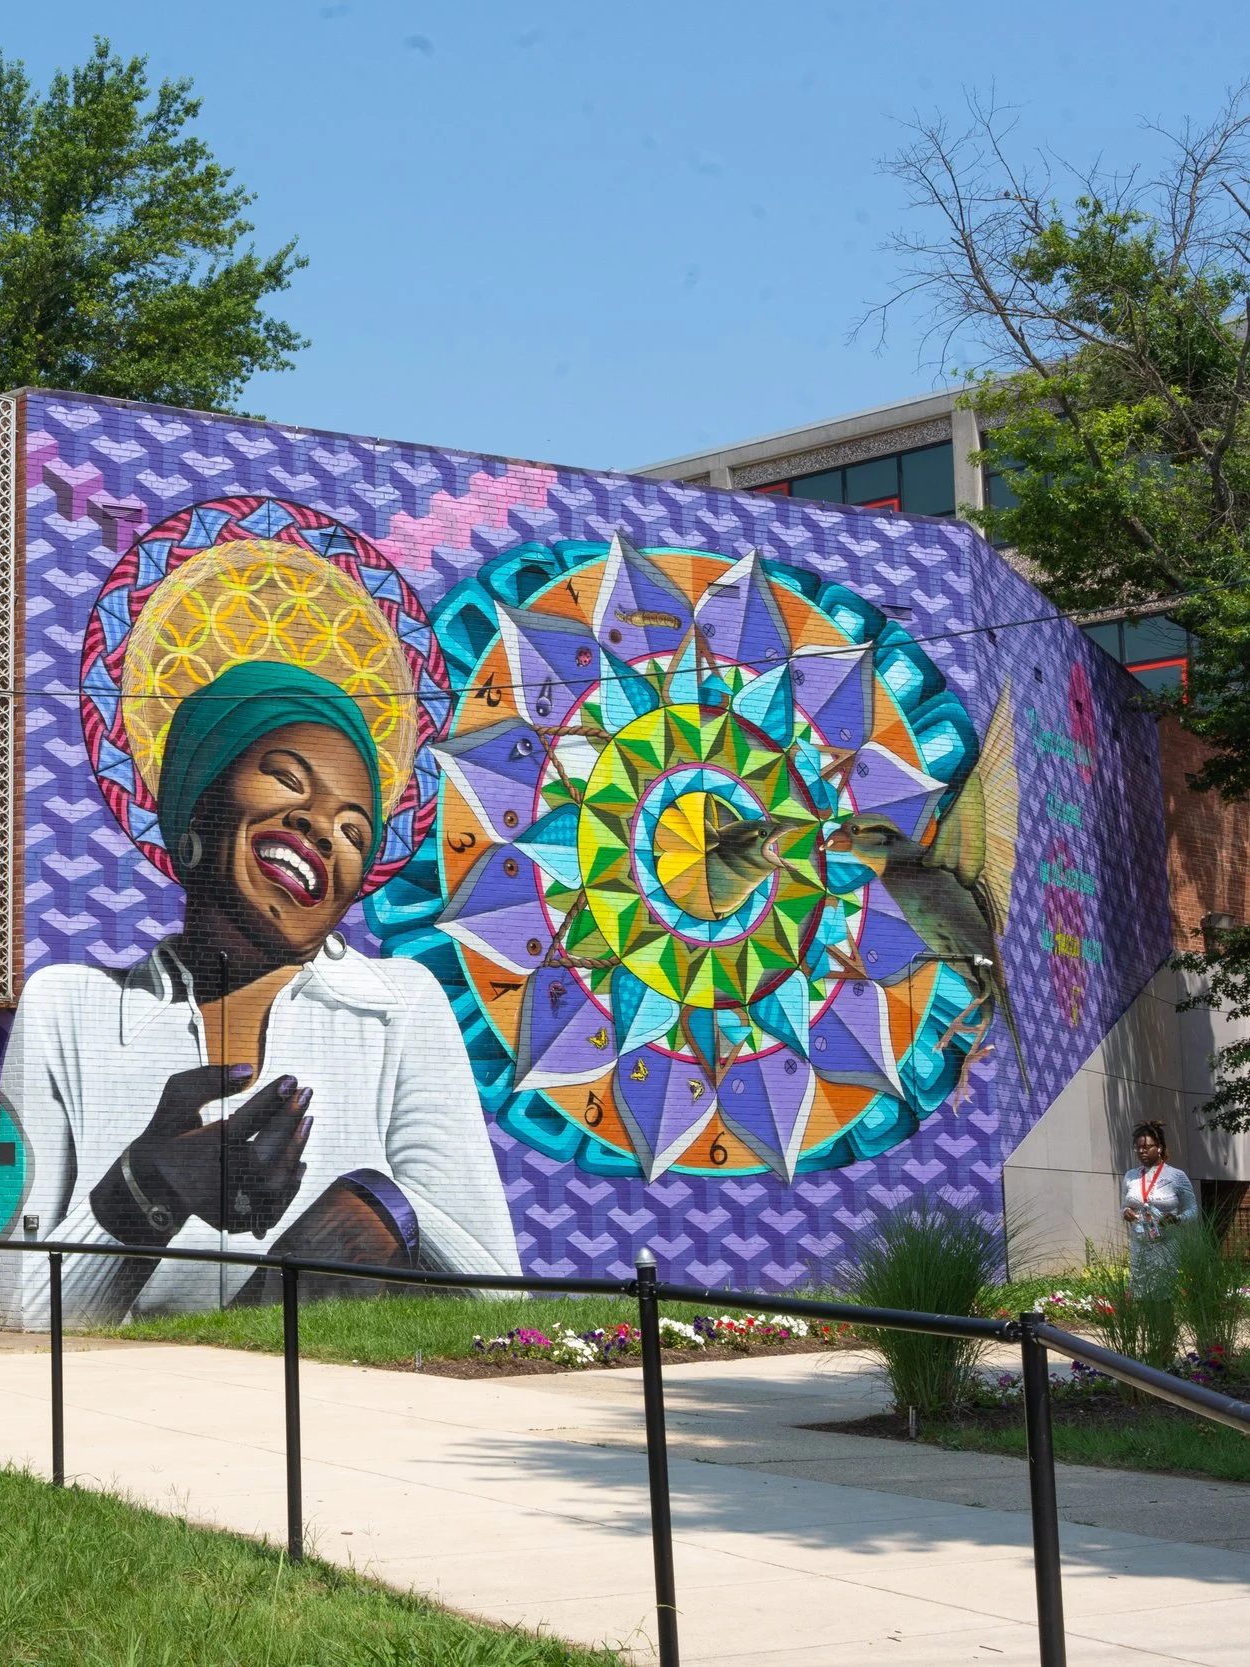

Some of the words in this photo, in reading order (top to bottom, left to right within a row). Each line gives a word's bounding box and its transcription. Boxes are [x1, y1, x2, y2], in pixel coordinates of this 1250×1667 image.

[565, 577, 580, 606] 1
[474, 671, 502, 707] 2
[446, 830, 476, 854] 3
[584, 1090, 606, 1127] 5
[709, 1131, 728, 1165] 6
